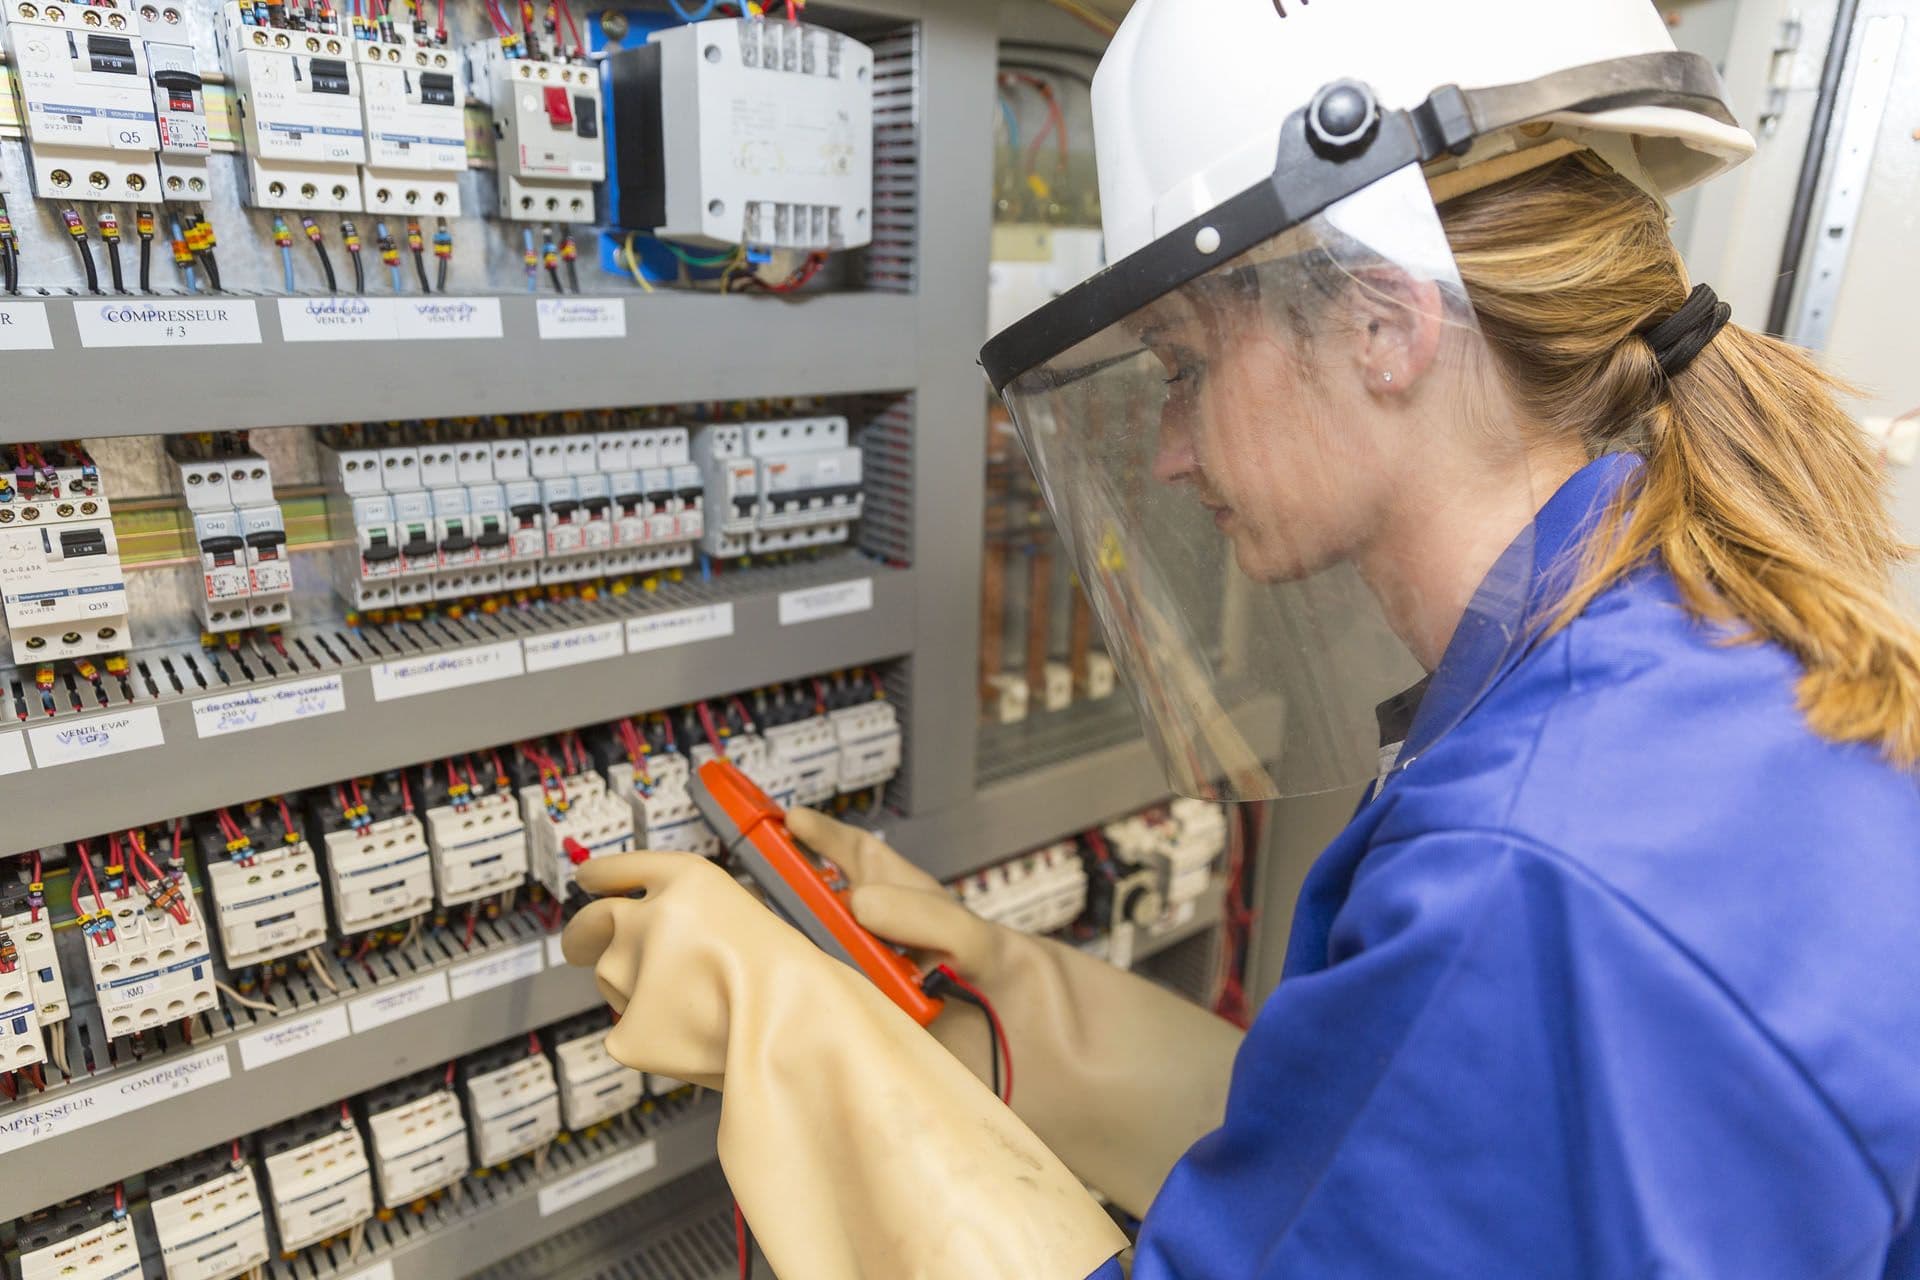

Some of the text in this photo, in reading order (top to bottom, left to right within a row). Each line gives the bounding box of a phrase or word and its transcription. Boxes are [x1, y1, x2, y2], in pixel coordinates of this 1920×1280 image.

[120, 131, 141, 144] Q5
[107, 309, 229, 323] COMPRESSEUR
[88, 601, 109, 612] Q39
[61, 720, 130, 738] VENTIL EVAP
[120, 1055, 225, 1095] COMPRESSEUR
